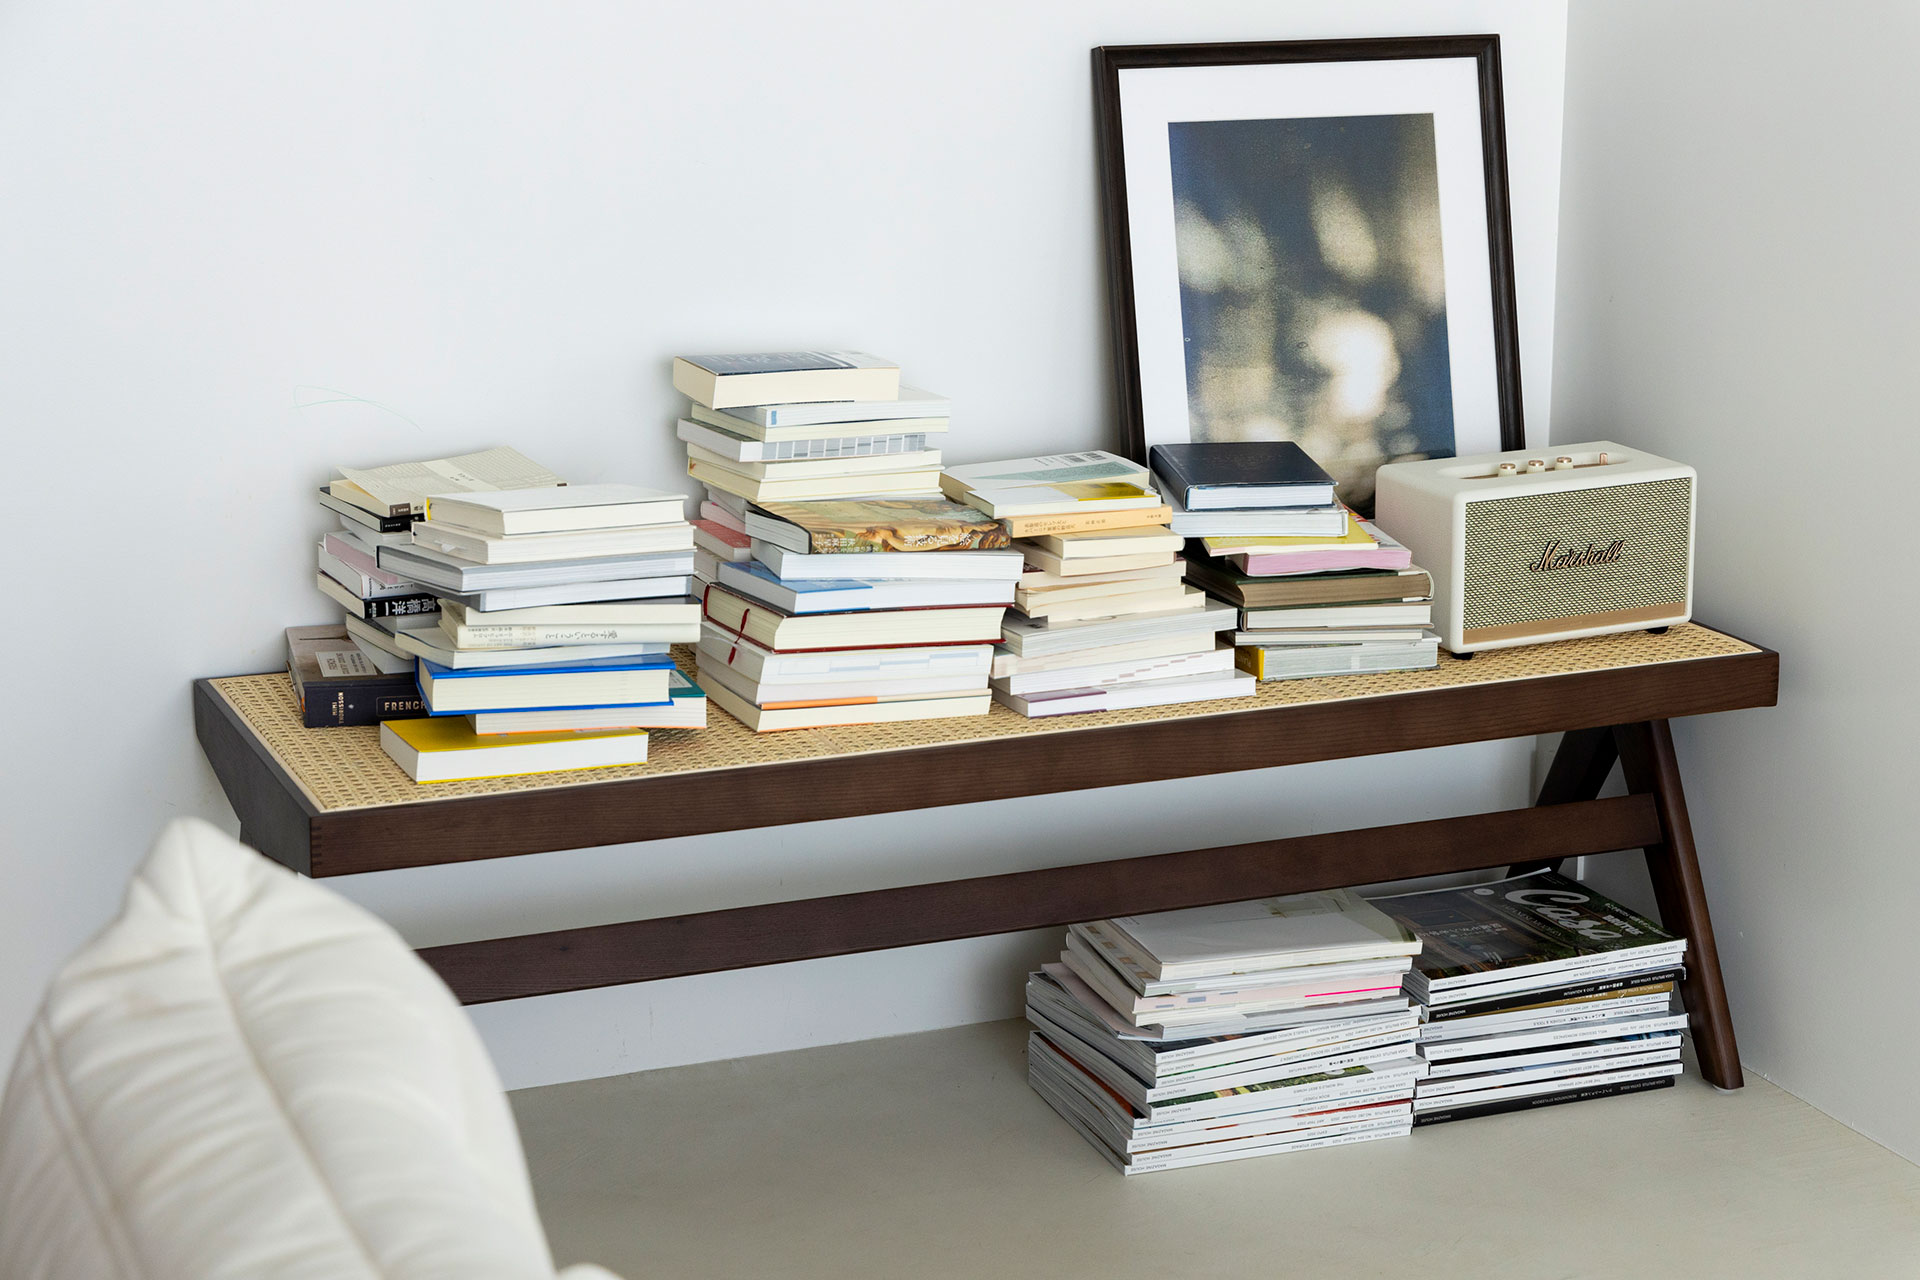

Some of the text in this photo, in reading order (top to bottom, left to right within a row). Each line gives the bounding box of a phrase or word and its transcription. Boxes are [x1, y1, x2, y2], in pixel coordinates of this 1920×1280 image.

[904, 533, 973, 548] 絵を見る技術
[1530, 540, 1625, 572] Marshall
[385, 598, 435, 616] 高橋洋一
[545, 629, 619, 641] 愛するということ
[337, 692, 345, 724] THORISSON
[1504, 889, 1623, 941] Casa
[1602, 914, 1644, 936] BRUTUS
